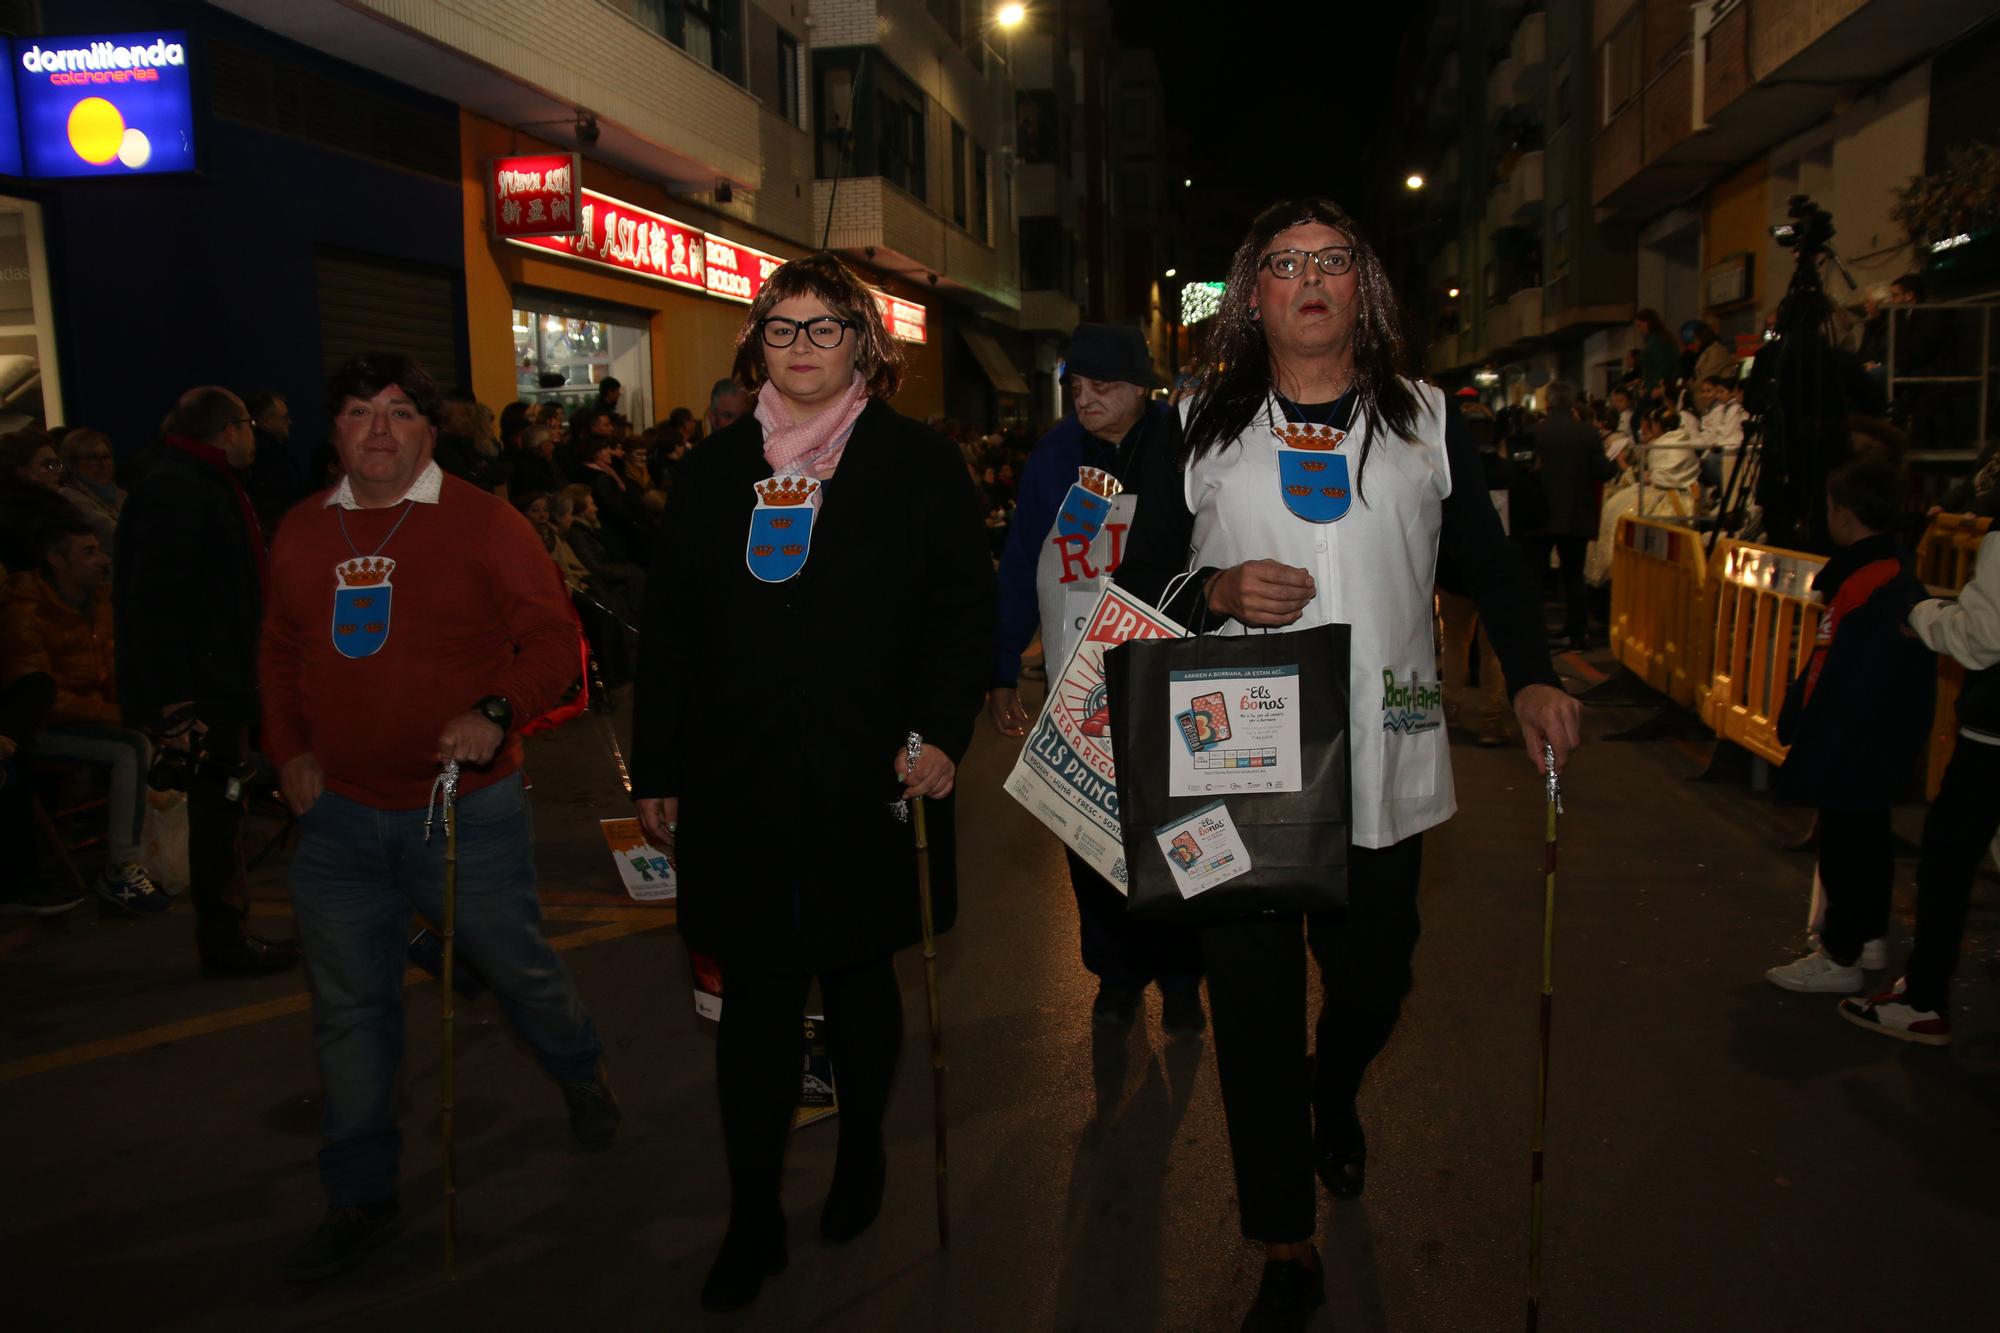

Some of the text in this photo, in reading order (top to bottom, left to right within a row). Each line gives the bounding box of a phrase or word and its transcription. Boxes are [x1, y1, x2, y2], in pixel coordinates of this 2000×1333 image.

[23, 39, 184, 72] dormitienda
[498, 163, 571, 198] NUEVA ASIA
[600, 211, 649, 267] ASIA
[1035, 721, 1069, 767] ELS
[1053, 703, 1073, 738] PER
[1073, 735, 1082, 750] A
